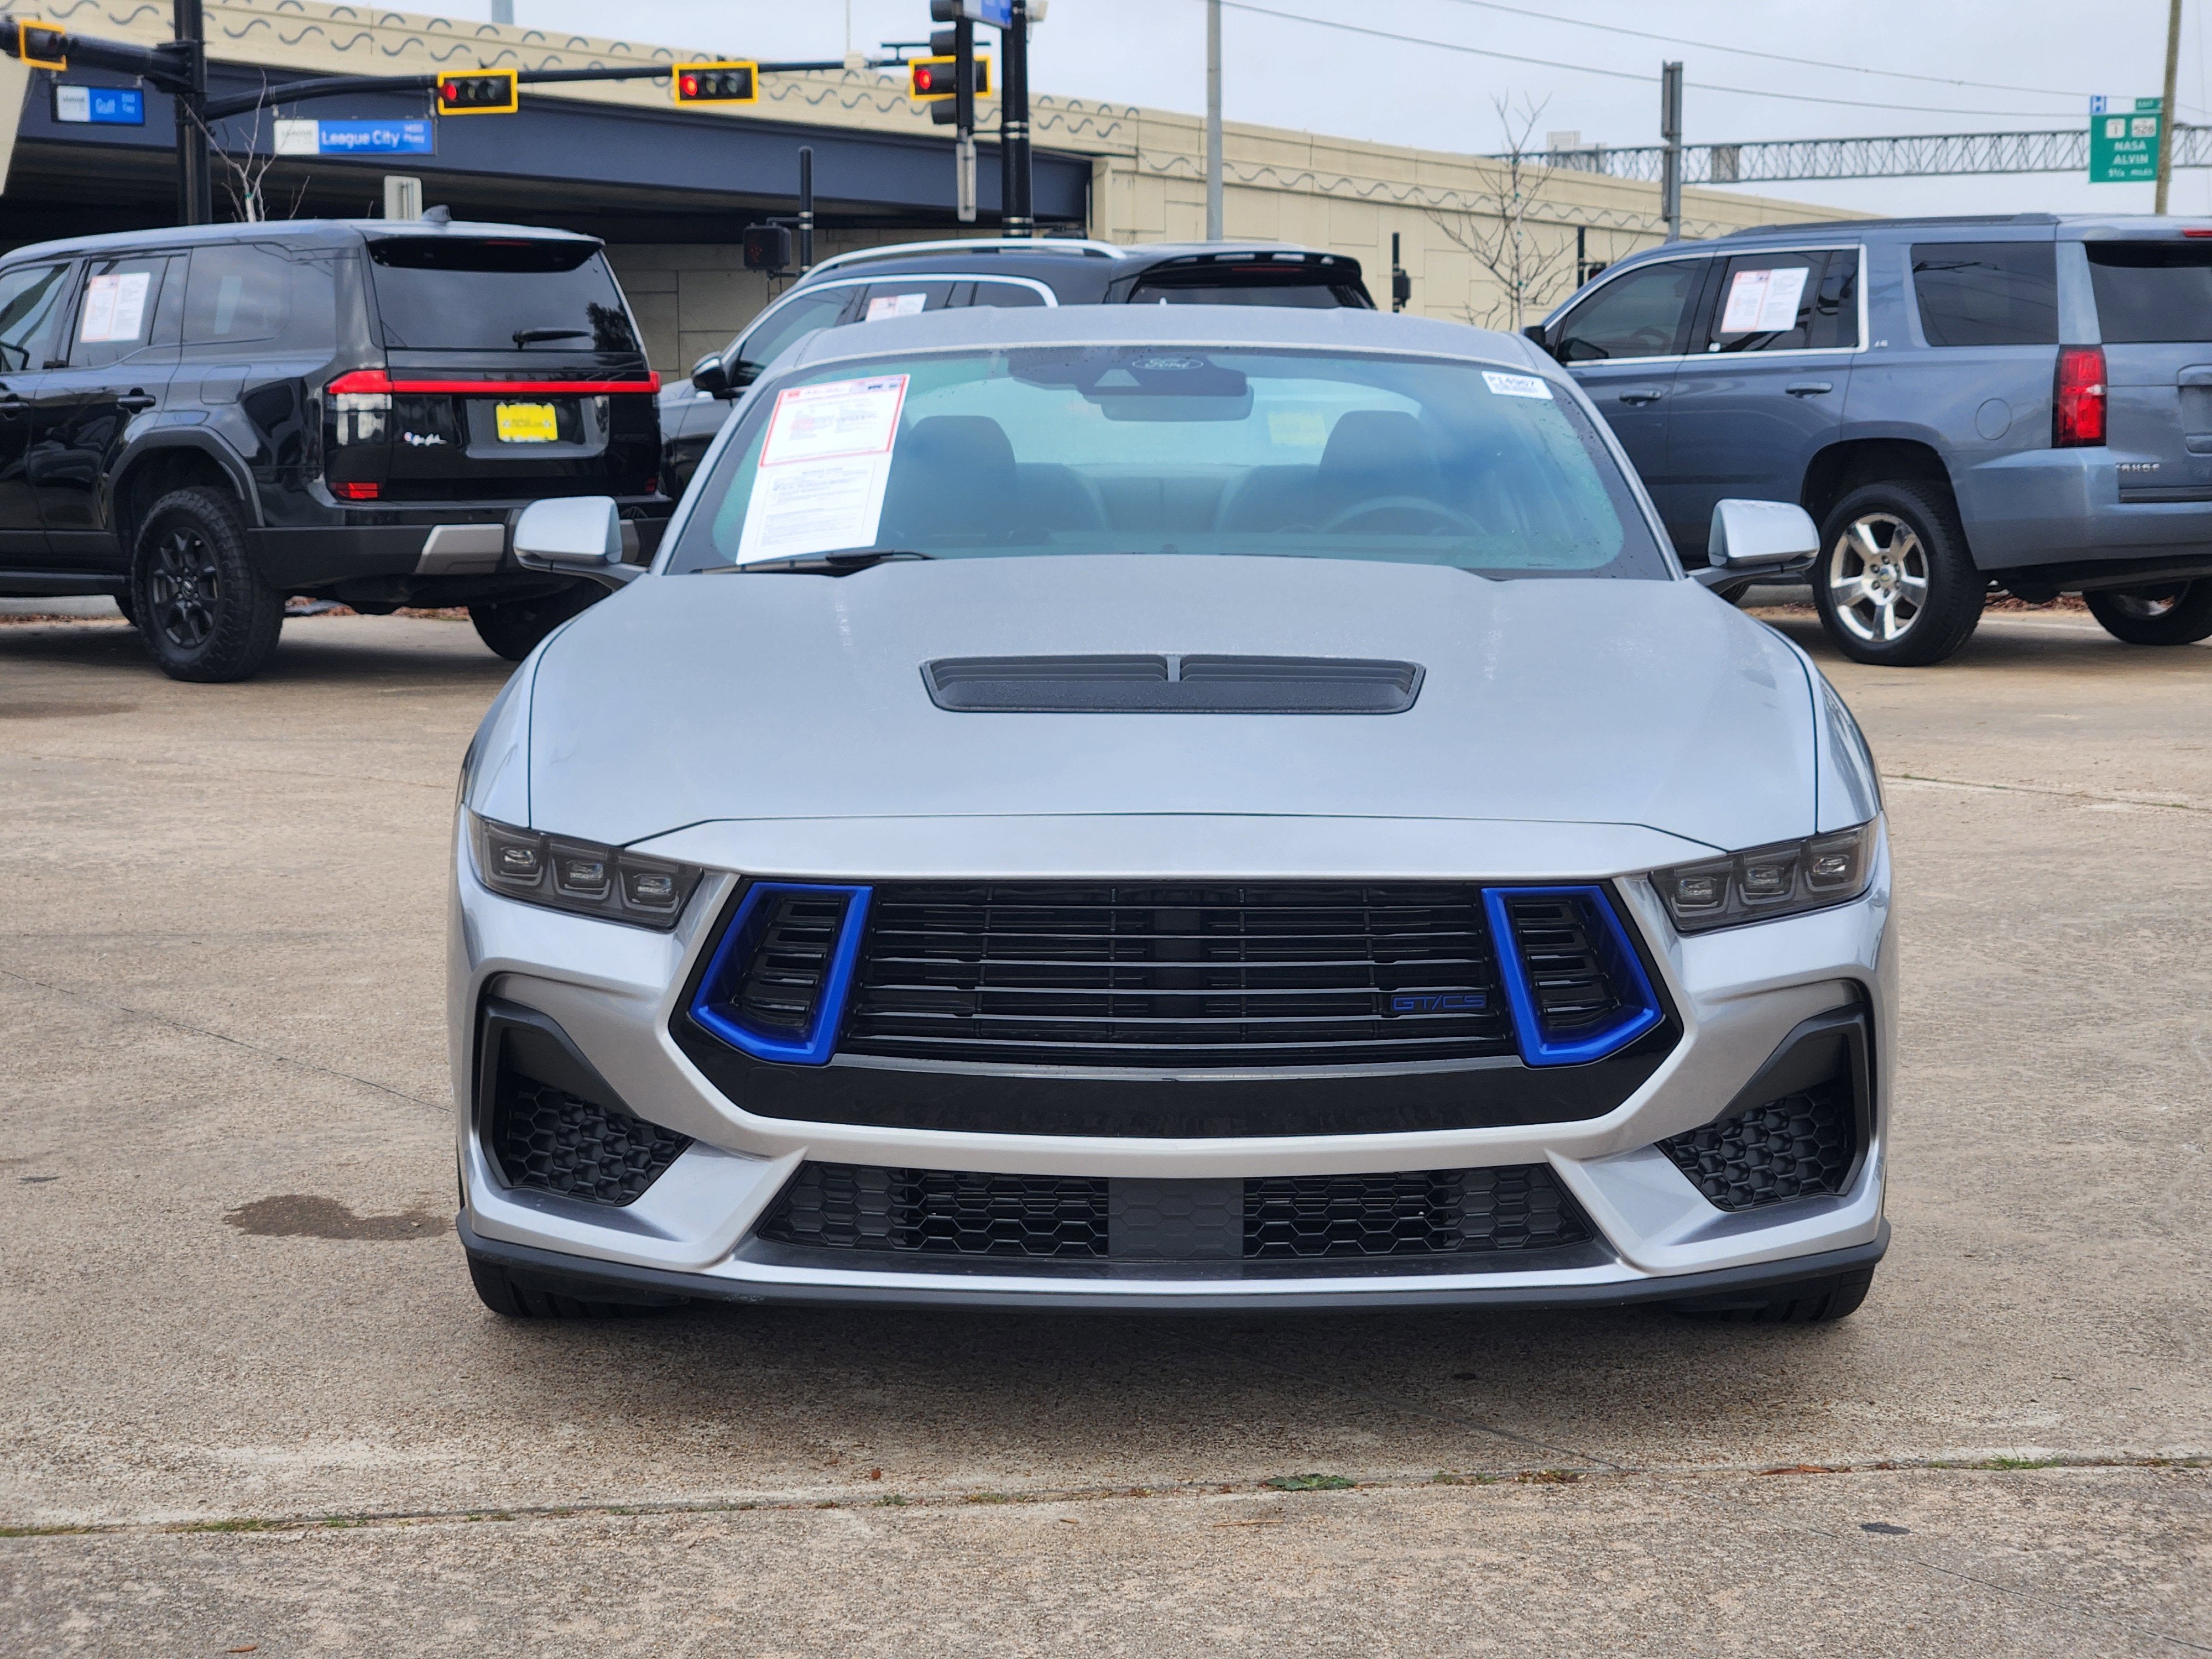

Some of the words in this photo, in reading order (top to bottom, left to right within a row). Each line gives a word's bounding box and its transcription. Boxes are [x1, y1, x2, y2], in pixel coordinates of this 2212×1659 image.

[321, 130, 371, 149] League
[372, 128, 400, 148] City
[2113, 140, 2147, 151] NASA
[2112, 153, 2149, 165] ALVIN
[1392, 994, 1485, 1012] GT/CS
